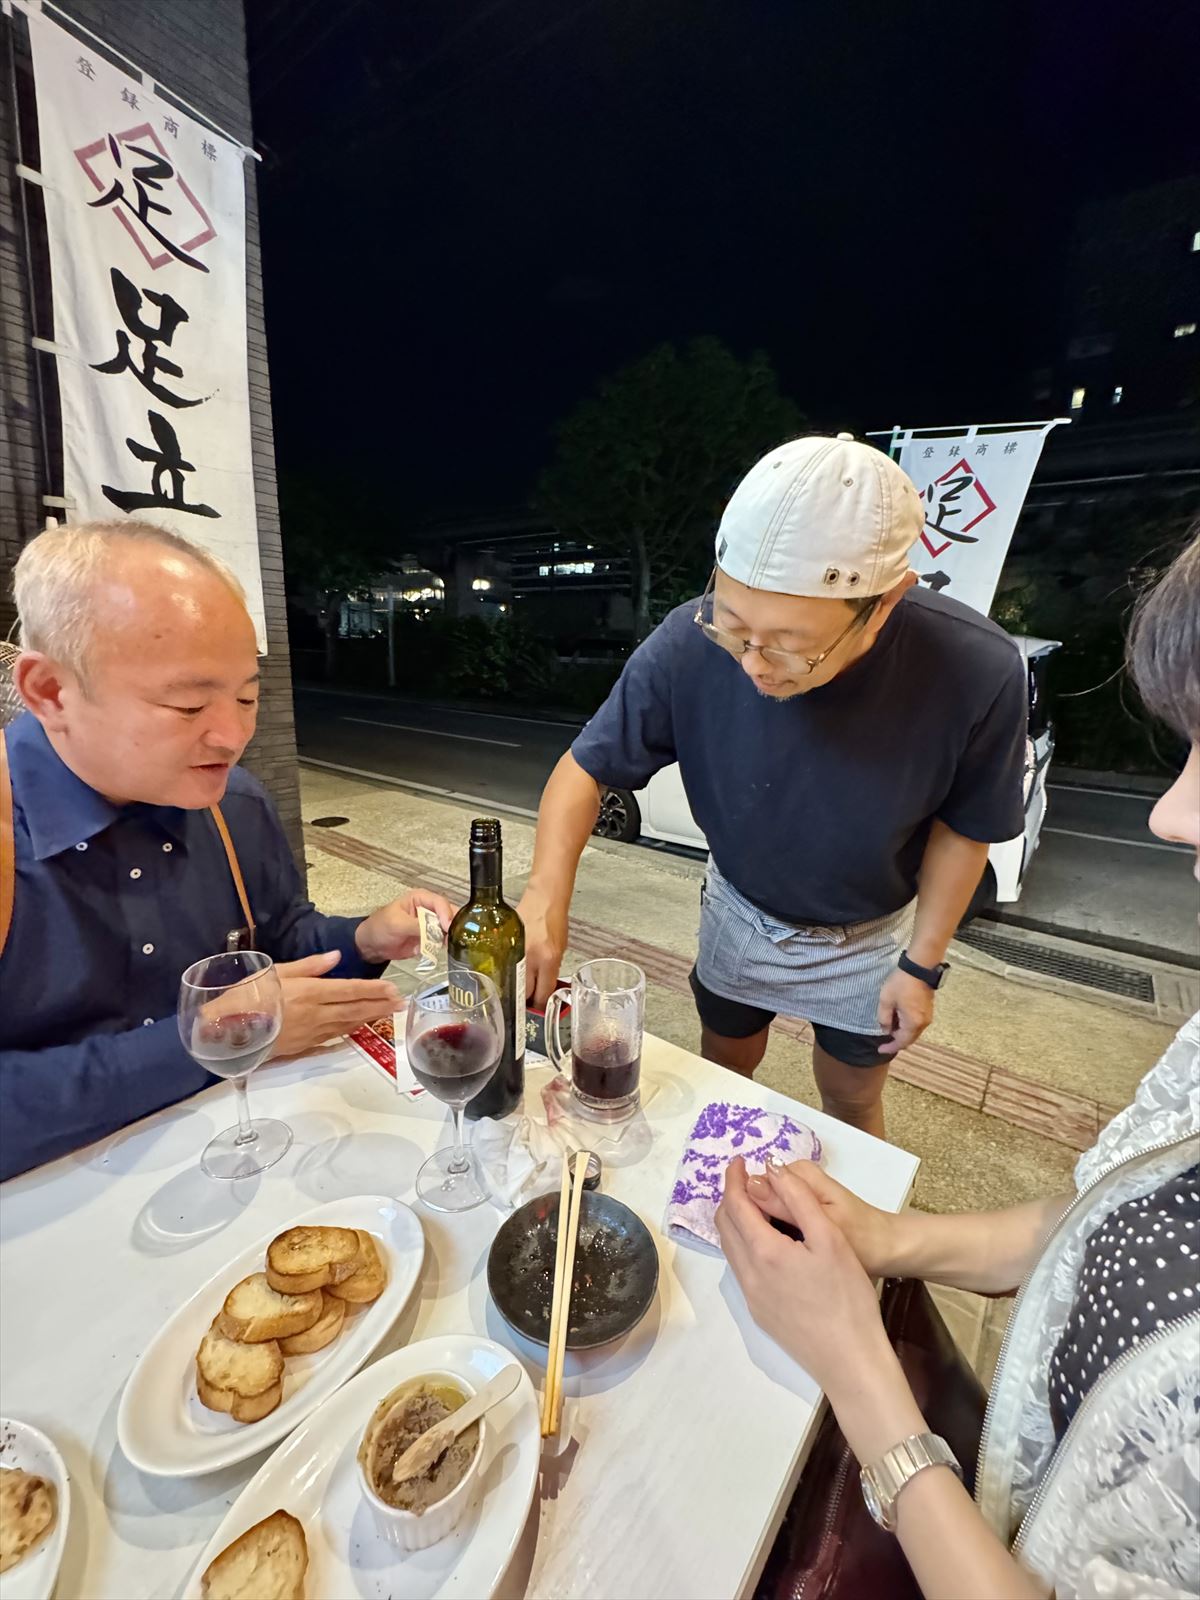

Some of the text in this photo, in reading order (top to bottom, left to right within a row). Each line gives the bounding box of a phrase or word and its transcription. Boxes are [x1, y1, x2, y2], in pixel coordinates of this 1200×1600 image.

[74, 55, 219, 163] 登録商標
[88, 266, 222, 519] 足立
[922, 441, 1018, 459] 登録商標
